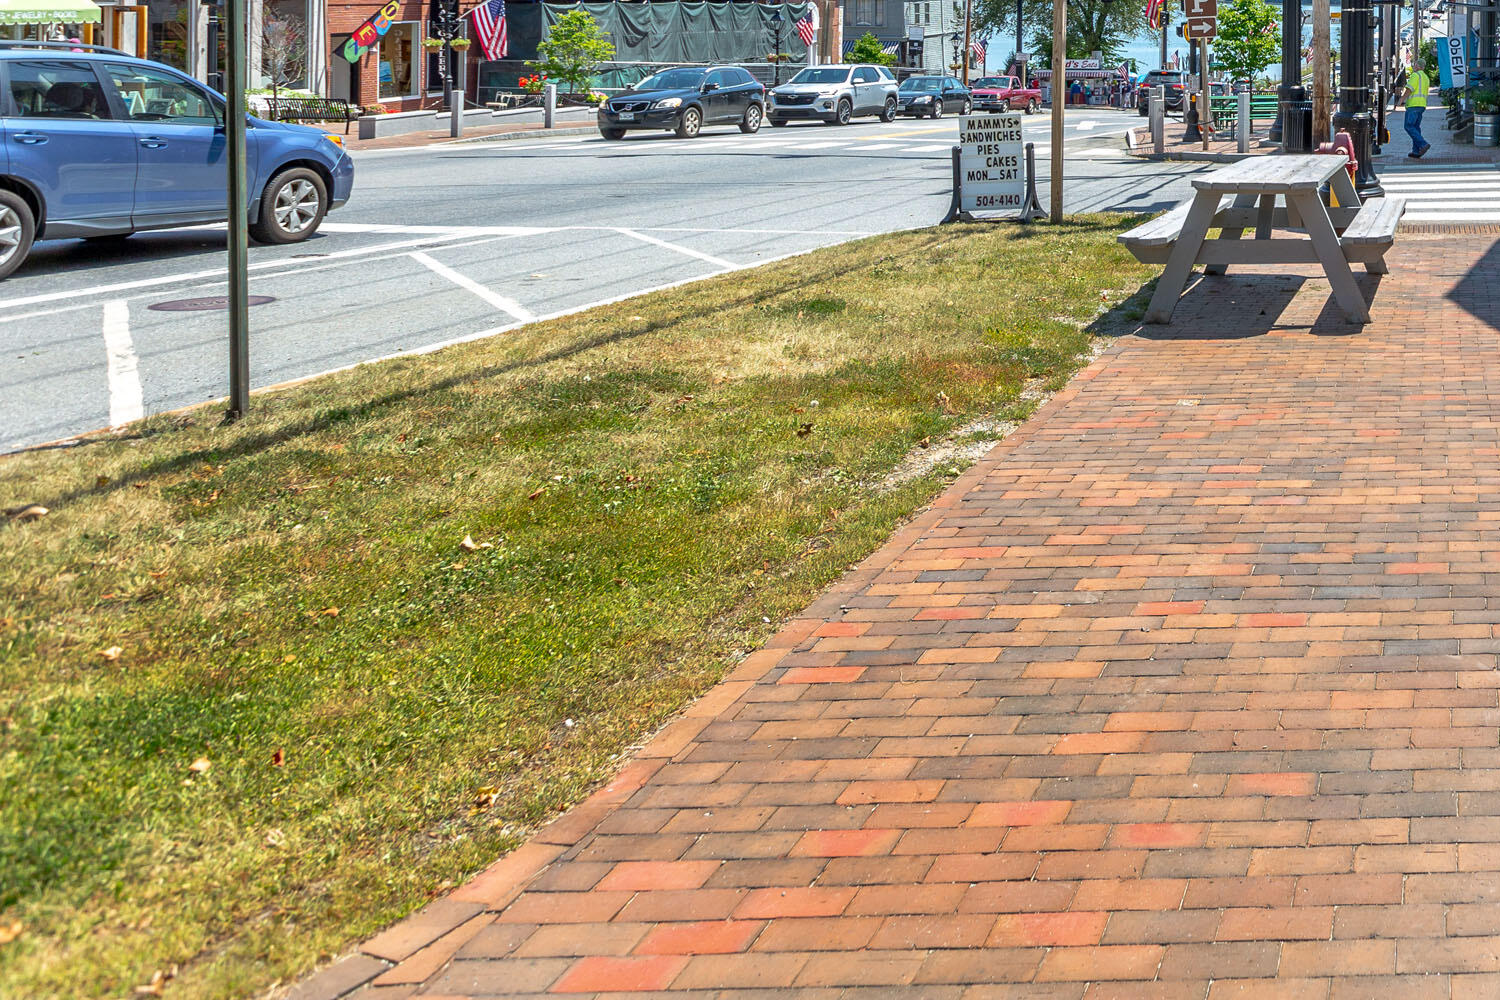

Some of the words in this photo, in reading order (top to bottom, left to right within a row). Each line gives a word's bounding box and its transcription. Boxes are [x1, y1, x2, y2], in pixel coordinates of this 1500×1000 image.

[1065, 60, 1079, 68] d's
[967, 118, 1013, 130] MAMMYS
[960, 130, 1021, 144] SANDWICHES
[977, 144, 1000, 155] PIES
[986, 156, 1018, 168] CAKES
[976, 195, 1020, 207] 504-4140
